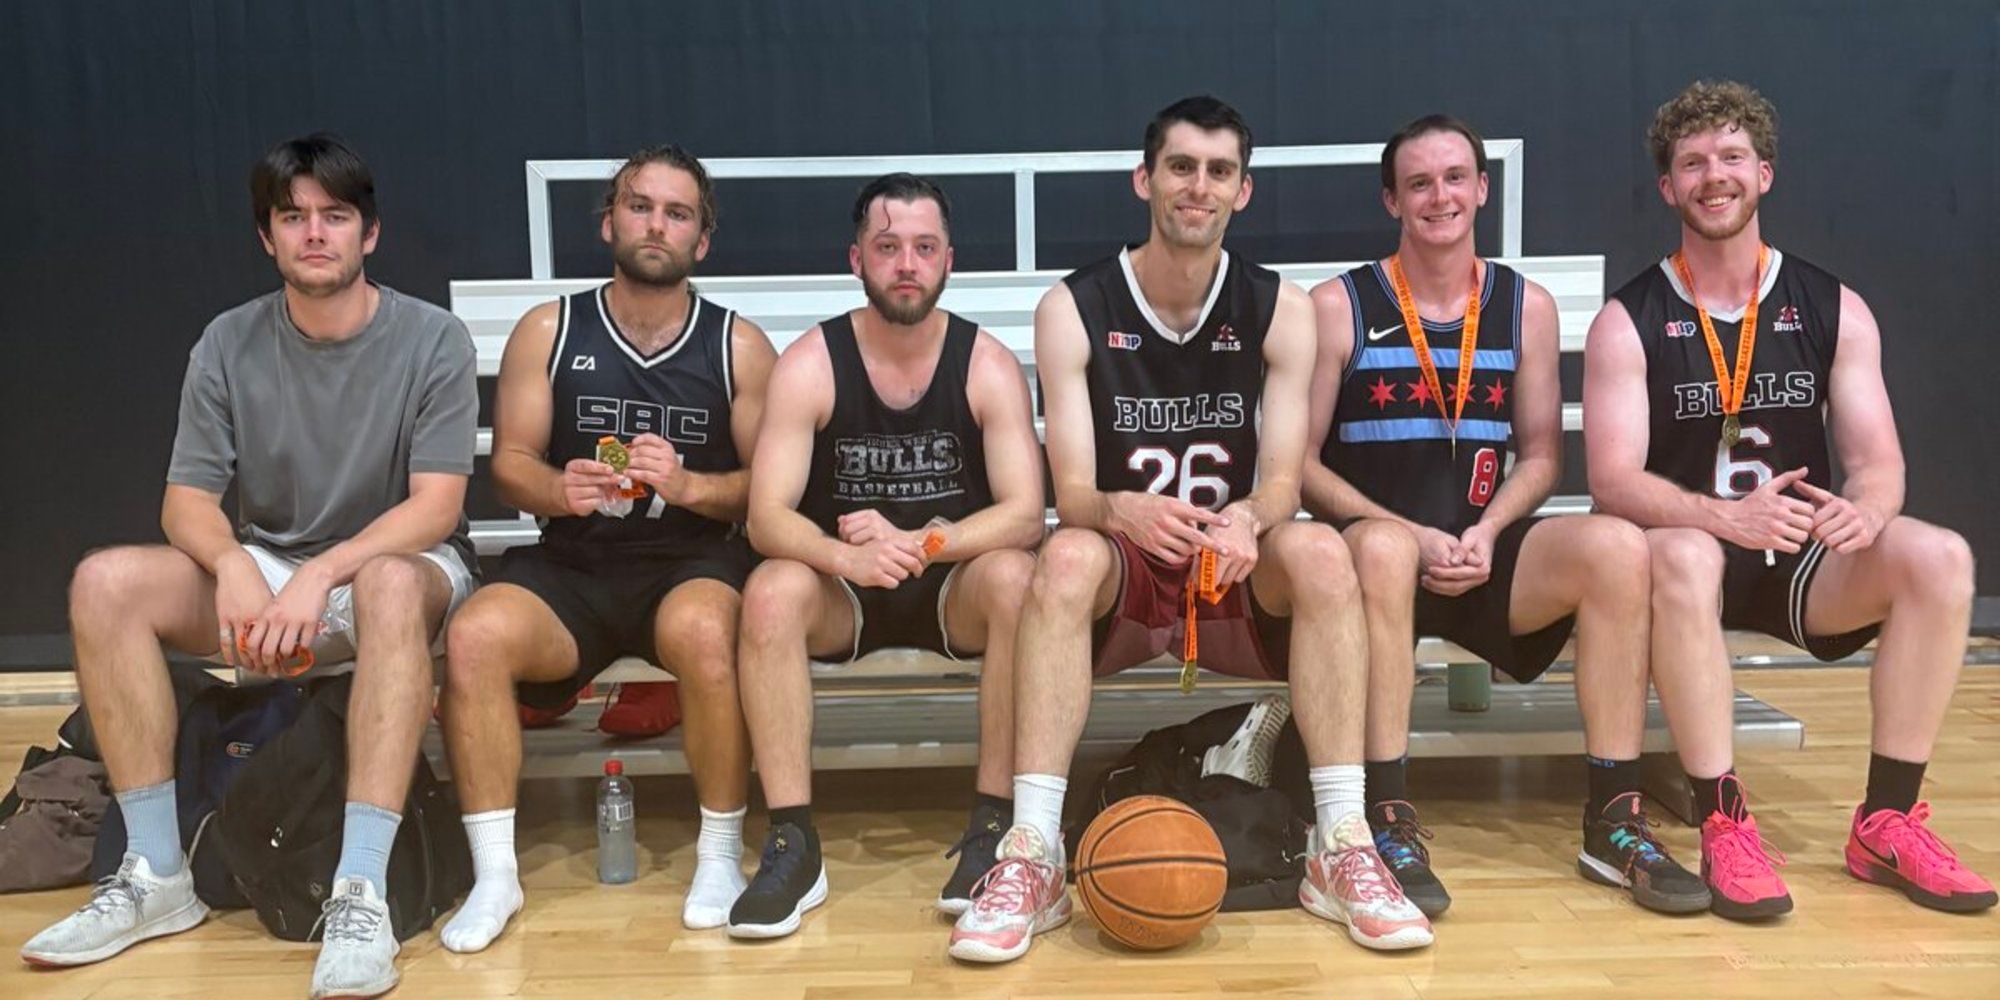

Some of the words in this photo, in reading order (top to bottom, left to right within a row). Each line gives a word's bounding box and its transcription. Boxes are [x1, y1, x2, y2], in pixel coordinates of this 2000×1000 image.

[577, 396, 709, 445] SBC
[1114, 393, 1244, 432] BULLS
[840, 438, 956, 476] BULLS
[1126, 441, 1233, 511] 26
[1468, 447, 1498, 507] 8
[1715, 426, 1773, 500] 6
[839, 479, 957, 495] BASKETBALL
